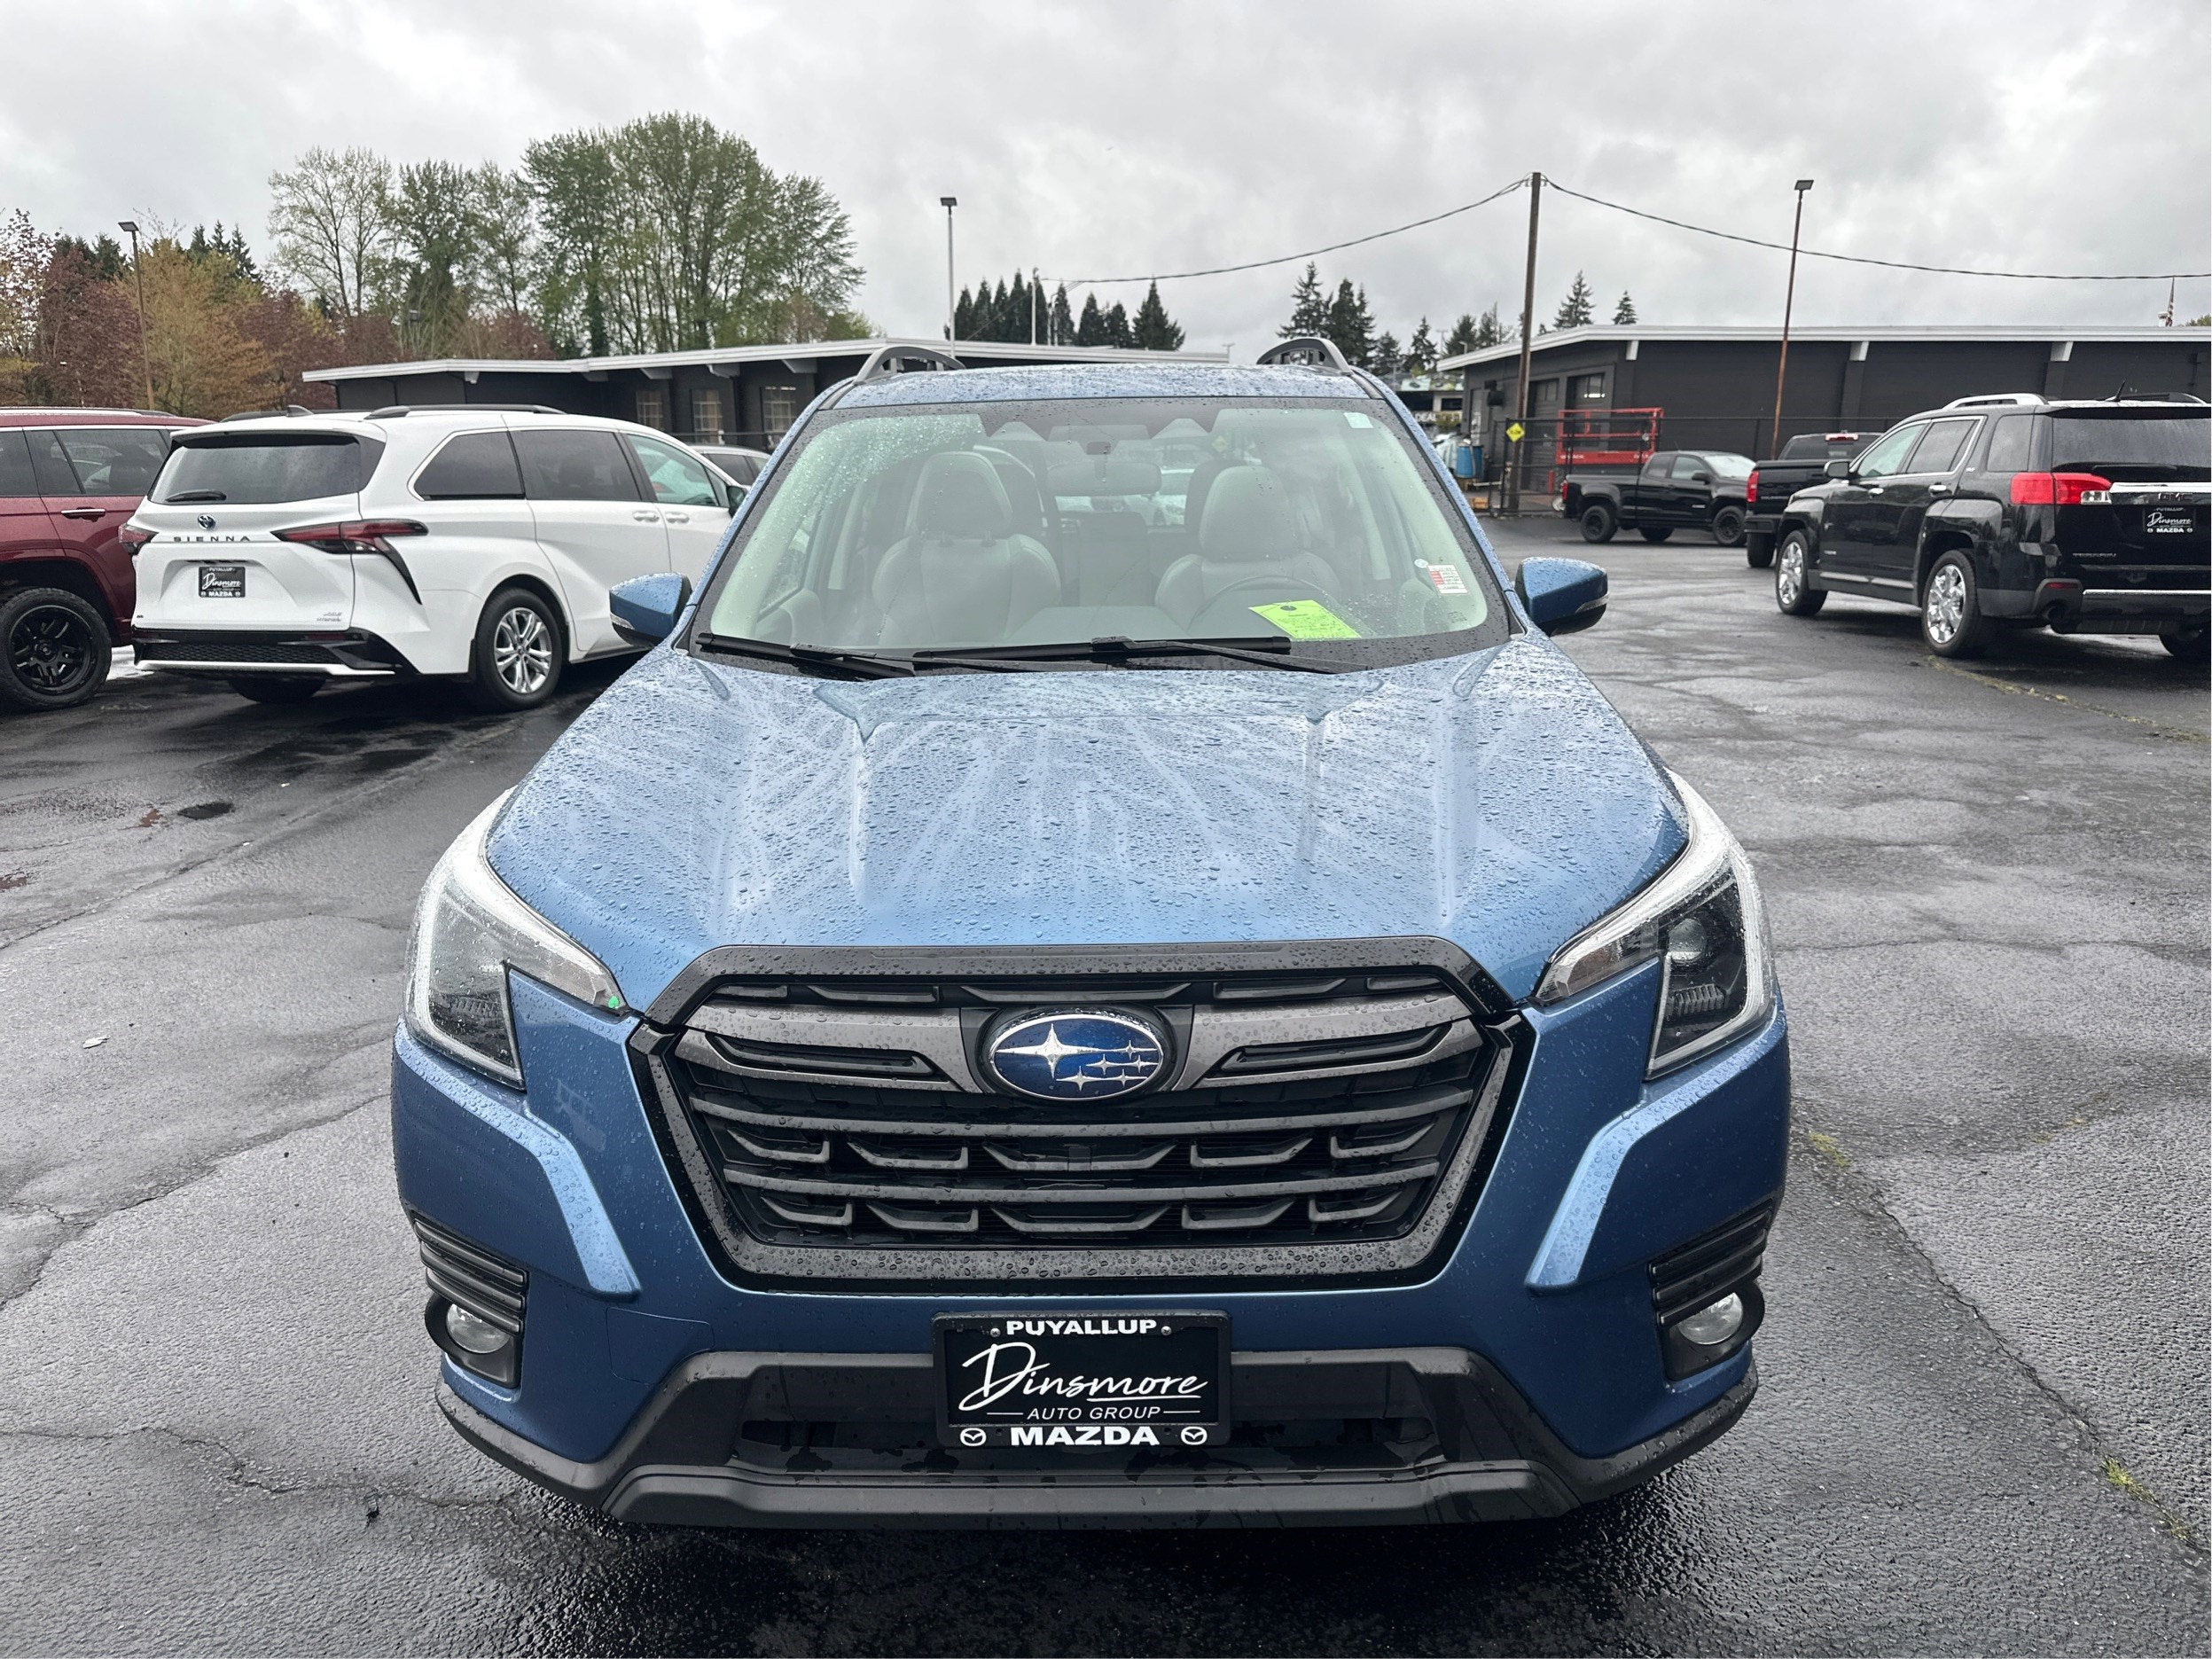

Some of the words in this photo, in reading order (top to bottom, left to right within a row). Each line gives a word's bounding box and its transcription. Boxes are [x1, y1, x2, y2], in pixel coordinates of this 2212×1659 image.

[1006, 1319, 1157, 1335] PUYALLUP
[958, 1342, 1208, 1412] Dinsmore
[1027, 1407, 1083, 1420] AUTO
[1089, 1406, 1161, 1420] GROUP
[1010, 1426, 1160, 1446] MAZDA
